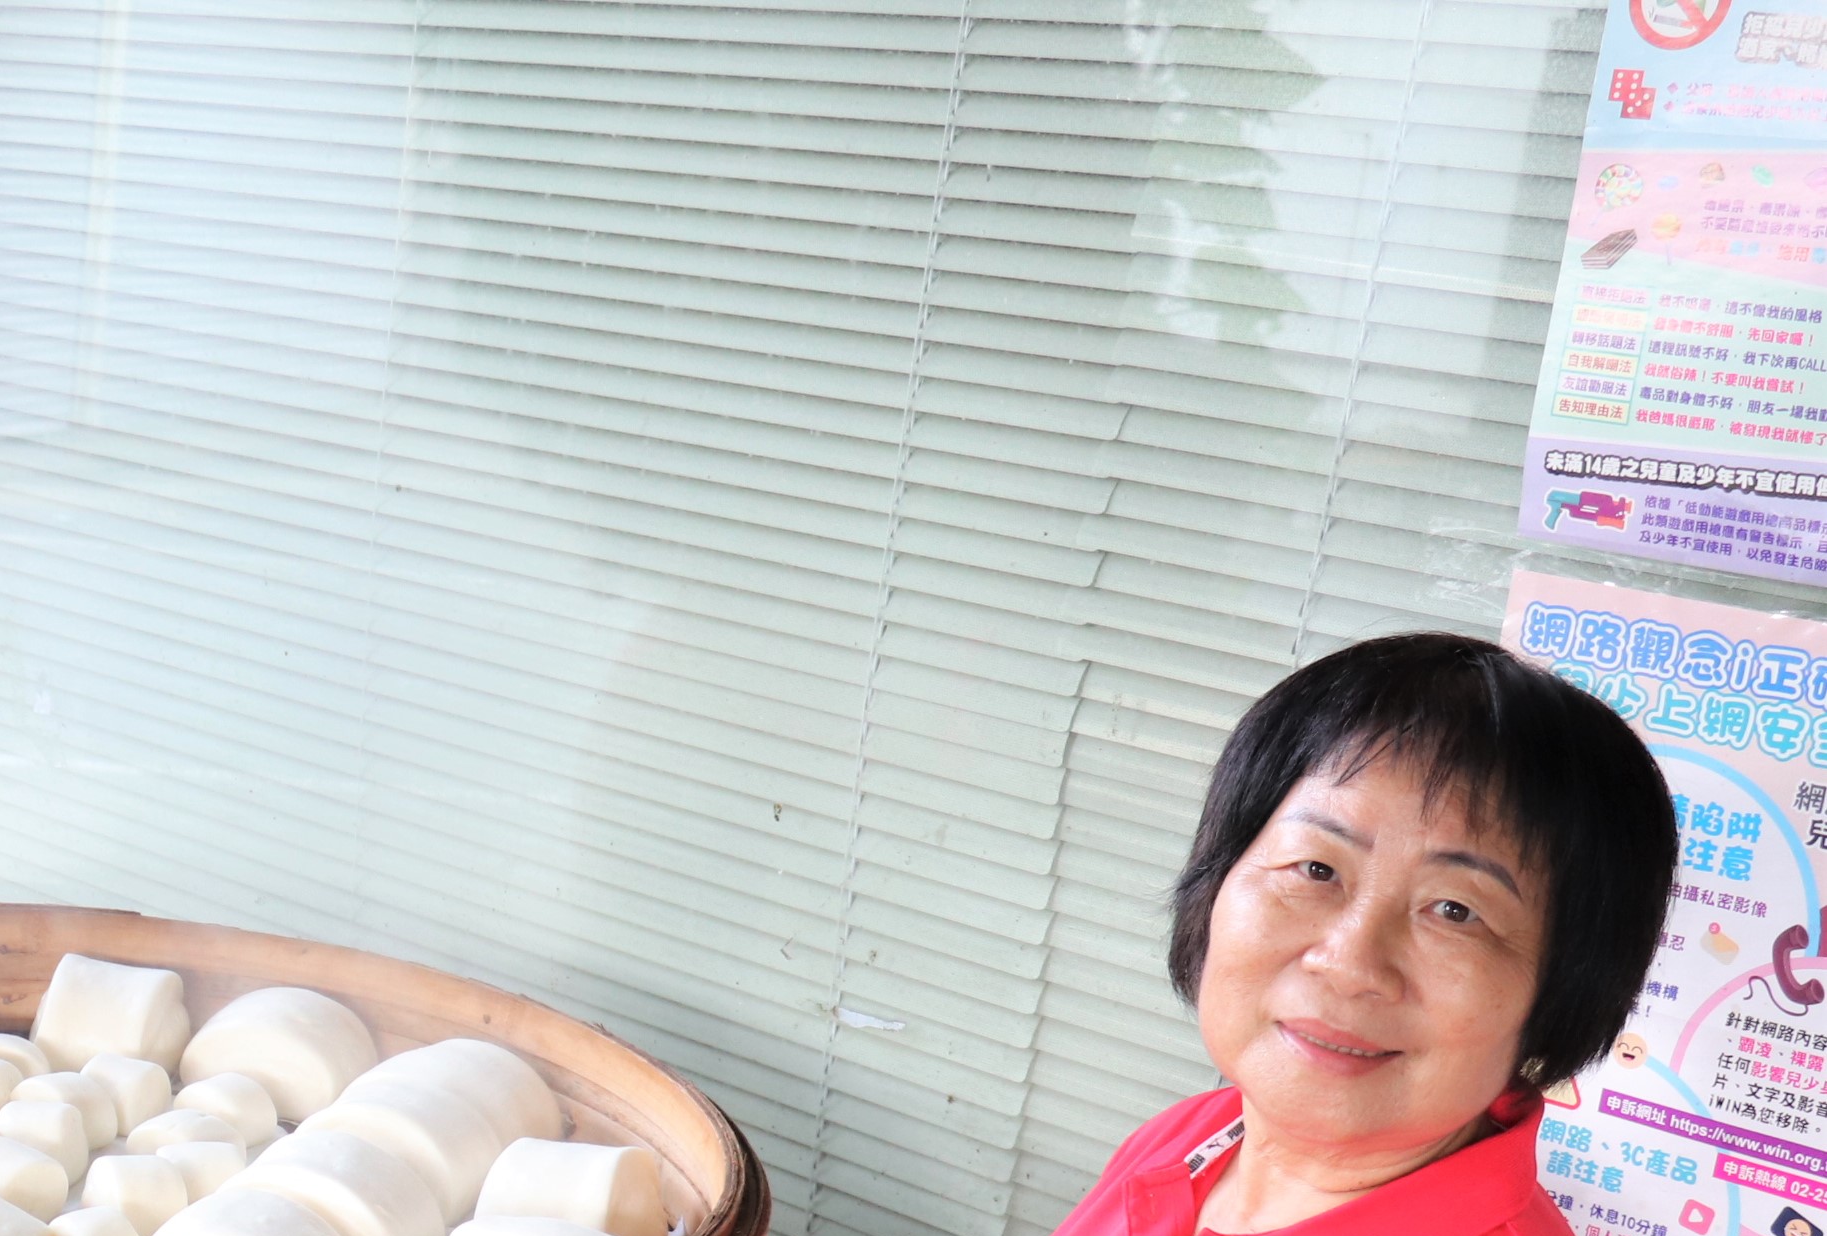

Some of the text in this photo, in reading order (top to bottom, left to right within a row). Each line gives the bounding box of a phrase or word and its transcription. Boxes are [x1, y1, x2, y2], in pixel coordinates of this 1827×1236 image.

[1571, 331, 1636, 351] 轉移話題法
[1567, 353, 1632, 373] 自我解嘲法
[1563, 376, 1628, 397] 友誼勸服法
[1559, 398, 1624, 419] 告知理由法
[1678, 834, 1754, 882] 注意
[1725, 1011, 1827, 1052] 針對網路內容
[1606, 1095, 1667, 1126] 申訴網址
[1546, 1150, 1624, 1194] 請注意
[1723, 1161, 1788, 1192] 申訴熱線
